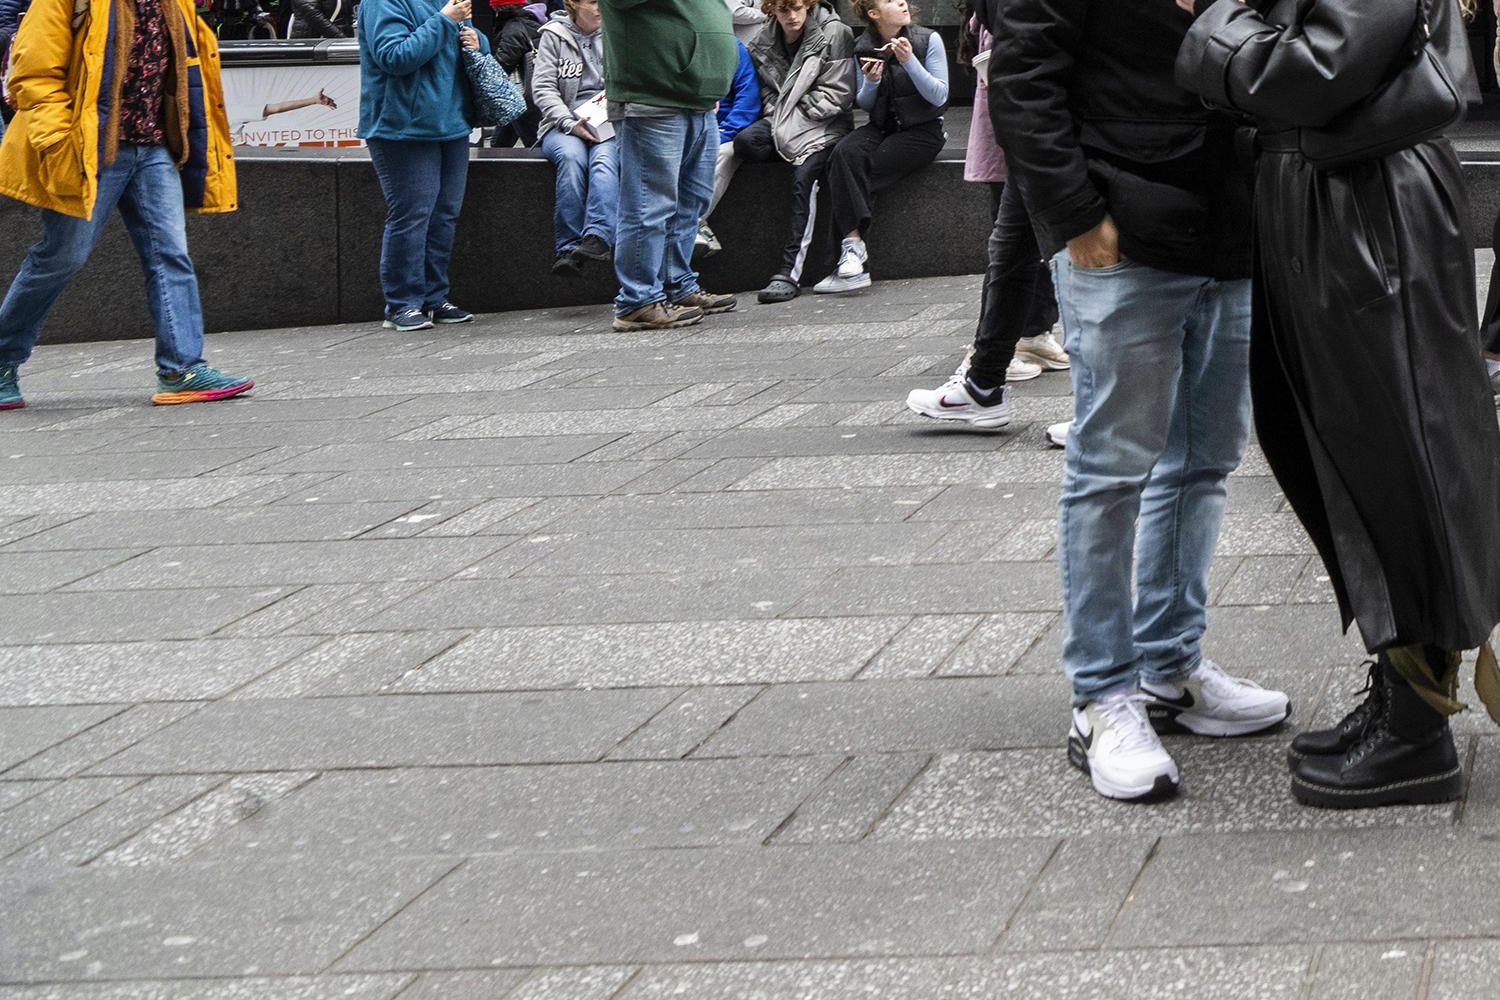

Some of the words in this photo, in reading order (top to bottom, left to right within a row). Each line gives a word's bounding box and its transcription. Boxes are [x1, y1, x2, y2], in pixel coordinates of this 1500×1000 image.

[240, 130, 301, 143] INVITED
[304, 128, 325, 140] TO
[328, 127, 358, 140] THIS
